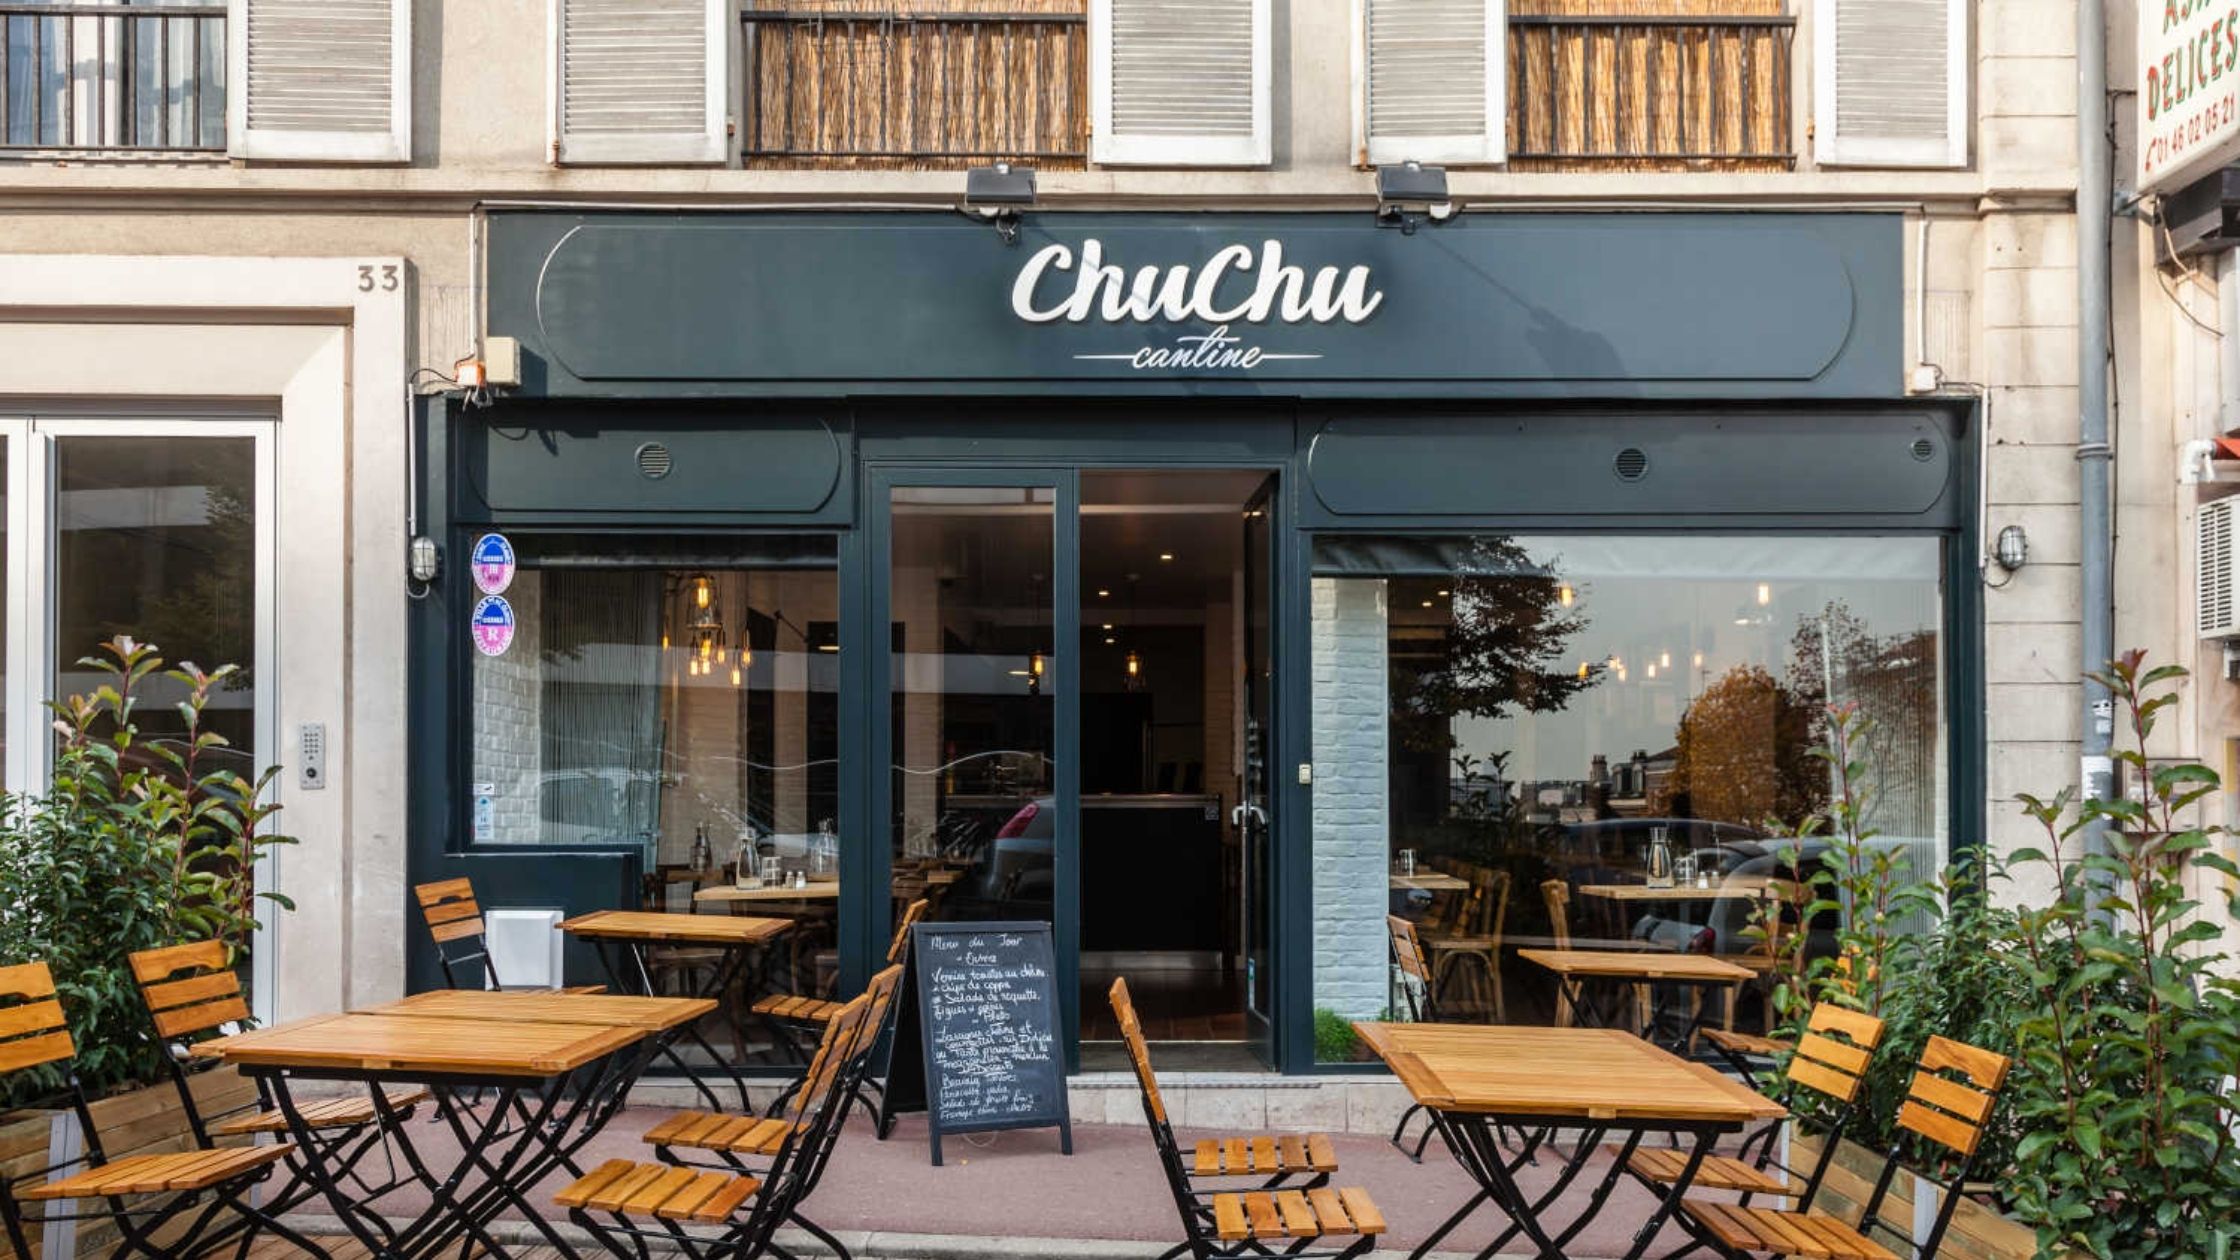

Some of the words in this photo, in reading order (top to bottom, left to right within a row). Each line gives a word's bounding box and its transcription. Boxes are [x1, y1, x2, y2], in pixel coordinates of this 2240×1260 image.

[2147, 9, 2238, 121] DELICES
[2157, 136, 2168, 164] 01
[2172, 124, 2184, 152] 46
[2188, 114, 2200, 145] 02
[2205, 103, 2218, 135] 05
[358, 265, 398, 292] 33
[1012, 239, 1383, 322] ChuChu
[1131, 325, 1266, 368] cantine
[968, 937, 984, 948] du
